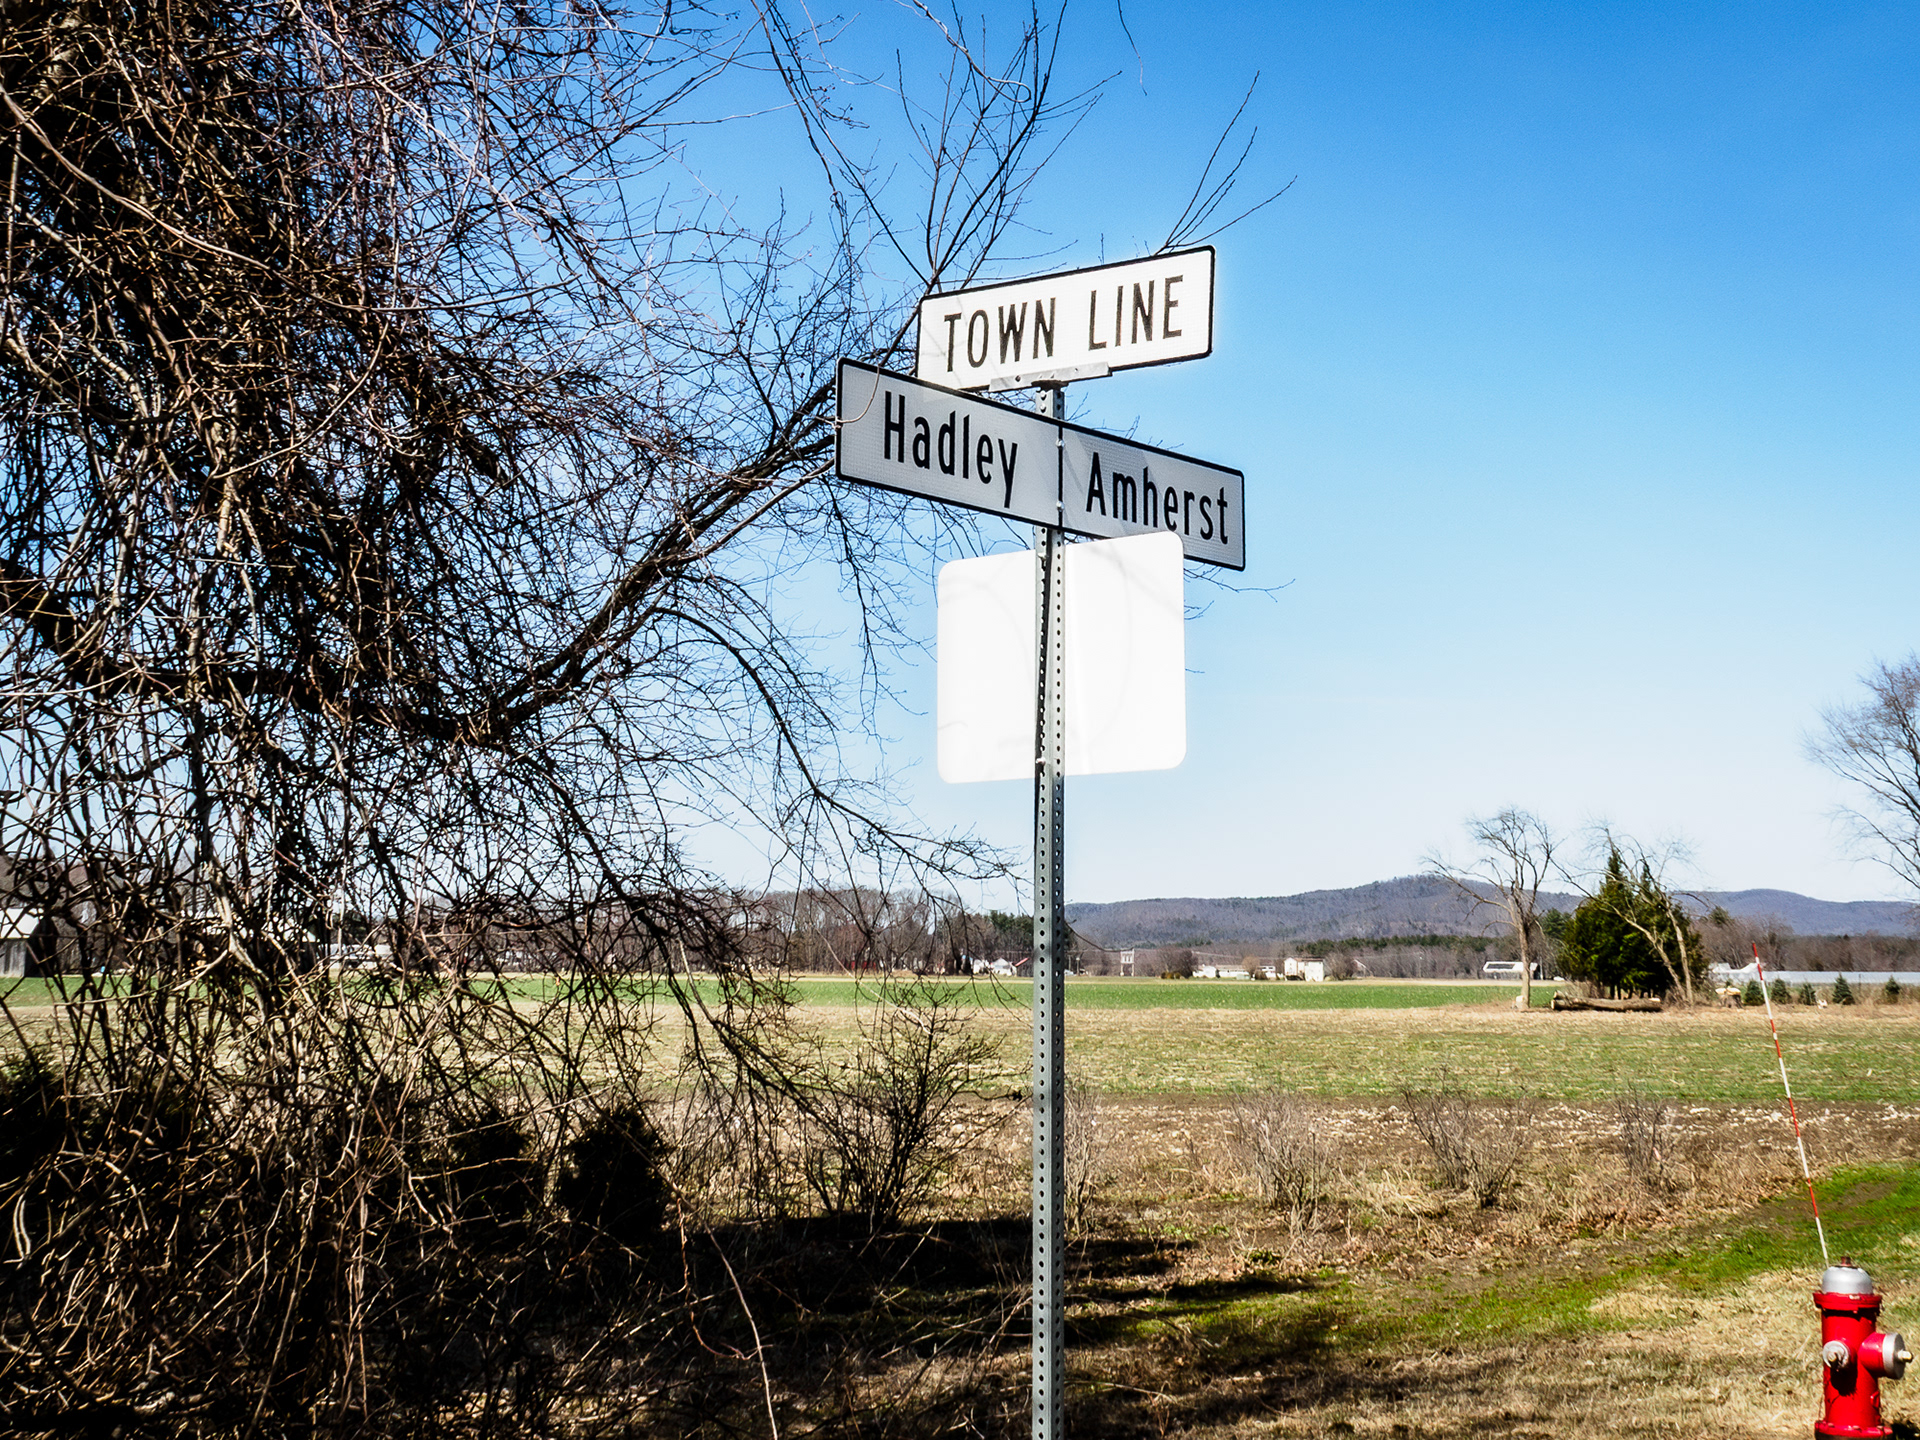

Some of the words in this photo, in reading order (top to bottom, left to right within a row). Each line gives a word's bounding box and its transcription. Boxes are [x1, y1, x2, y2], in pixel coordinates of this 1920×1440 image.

[944, 297, 1056, 373] TOWN
[1088, 274, 1184, 351] LINE
[883, 390, 1018, 509] Hadley
[1086, 452, 1229, 545] Amherst
